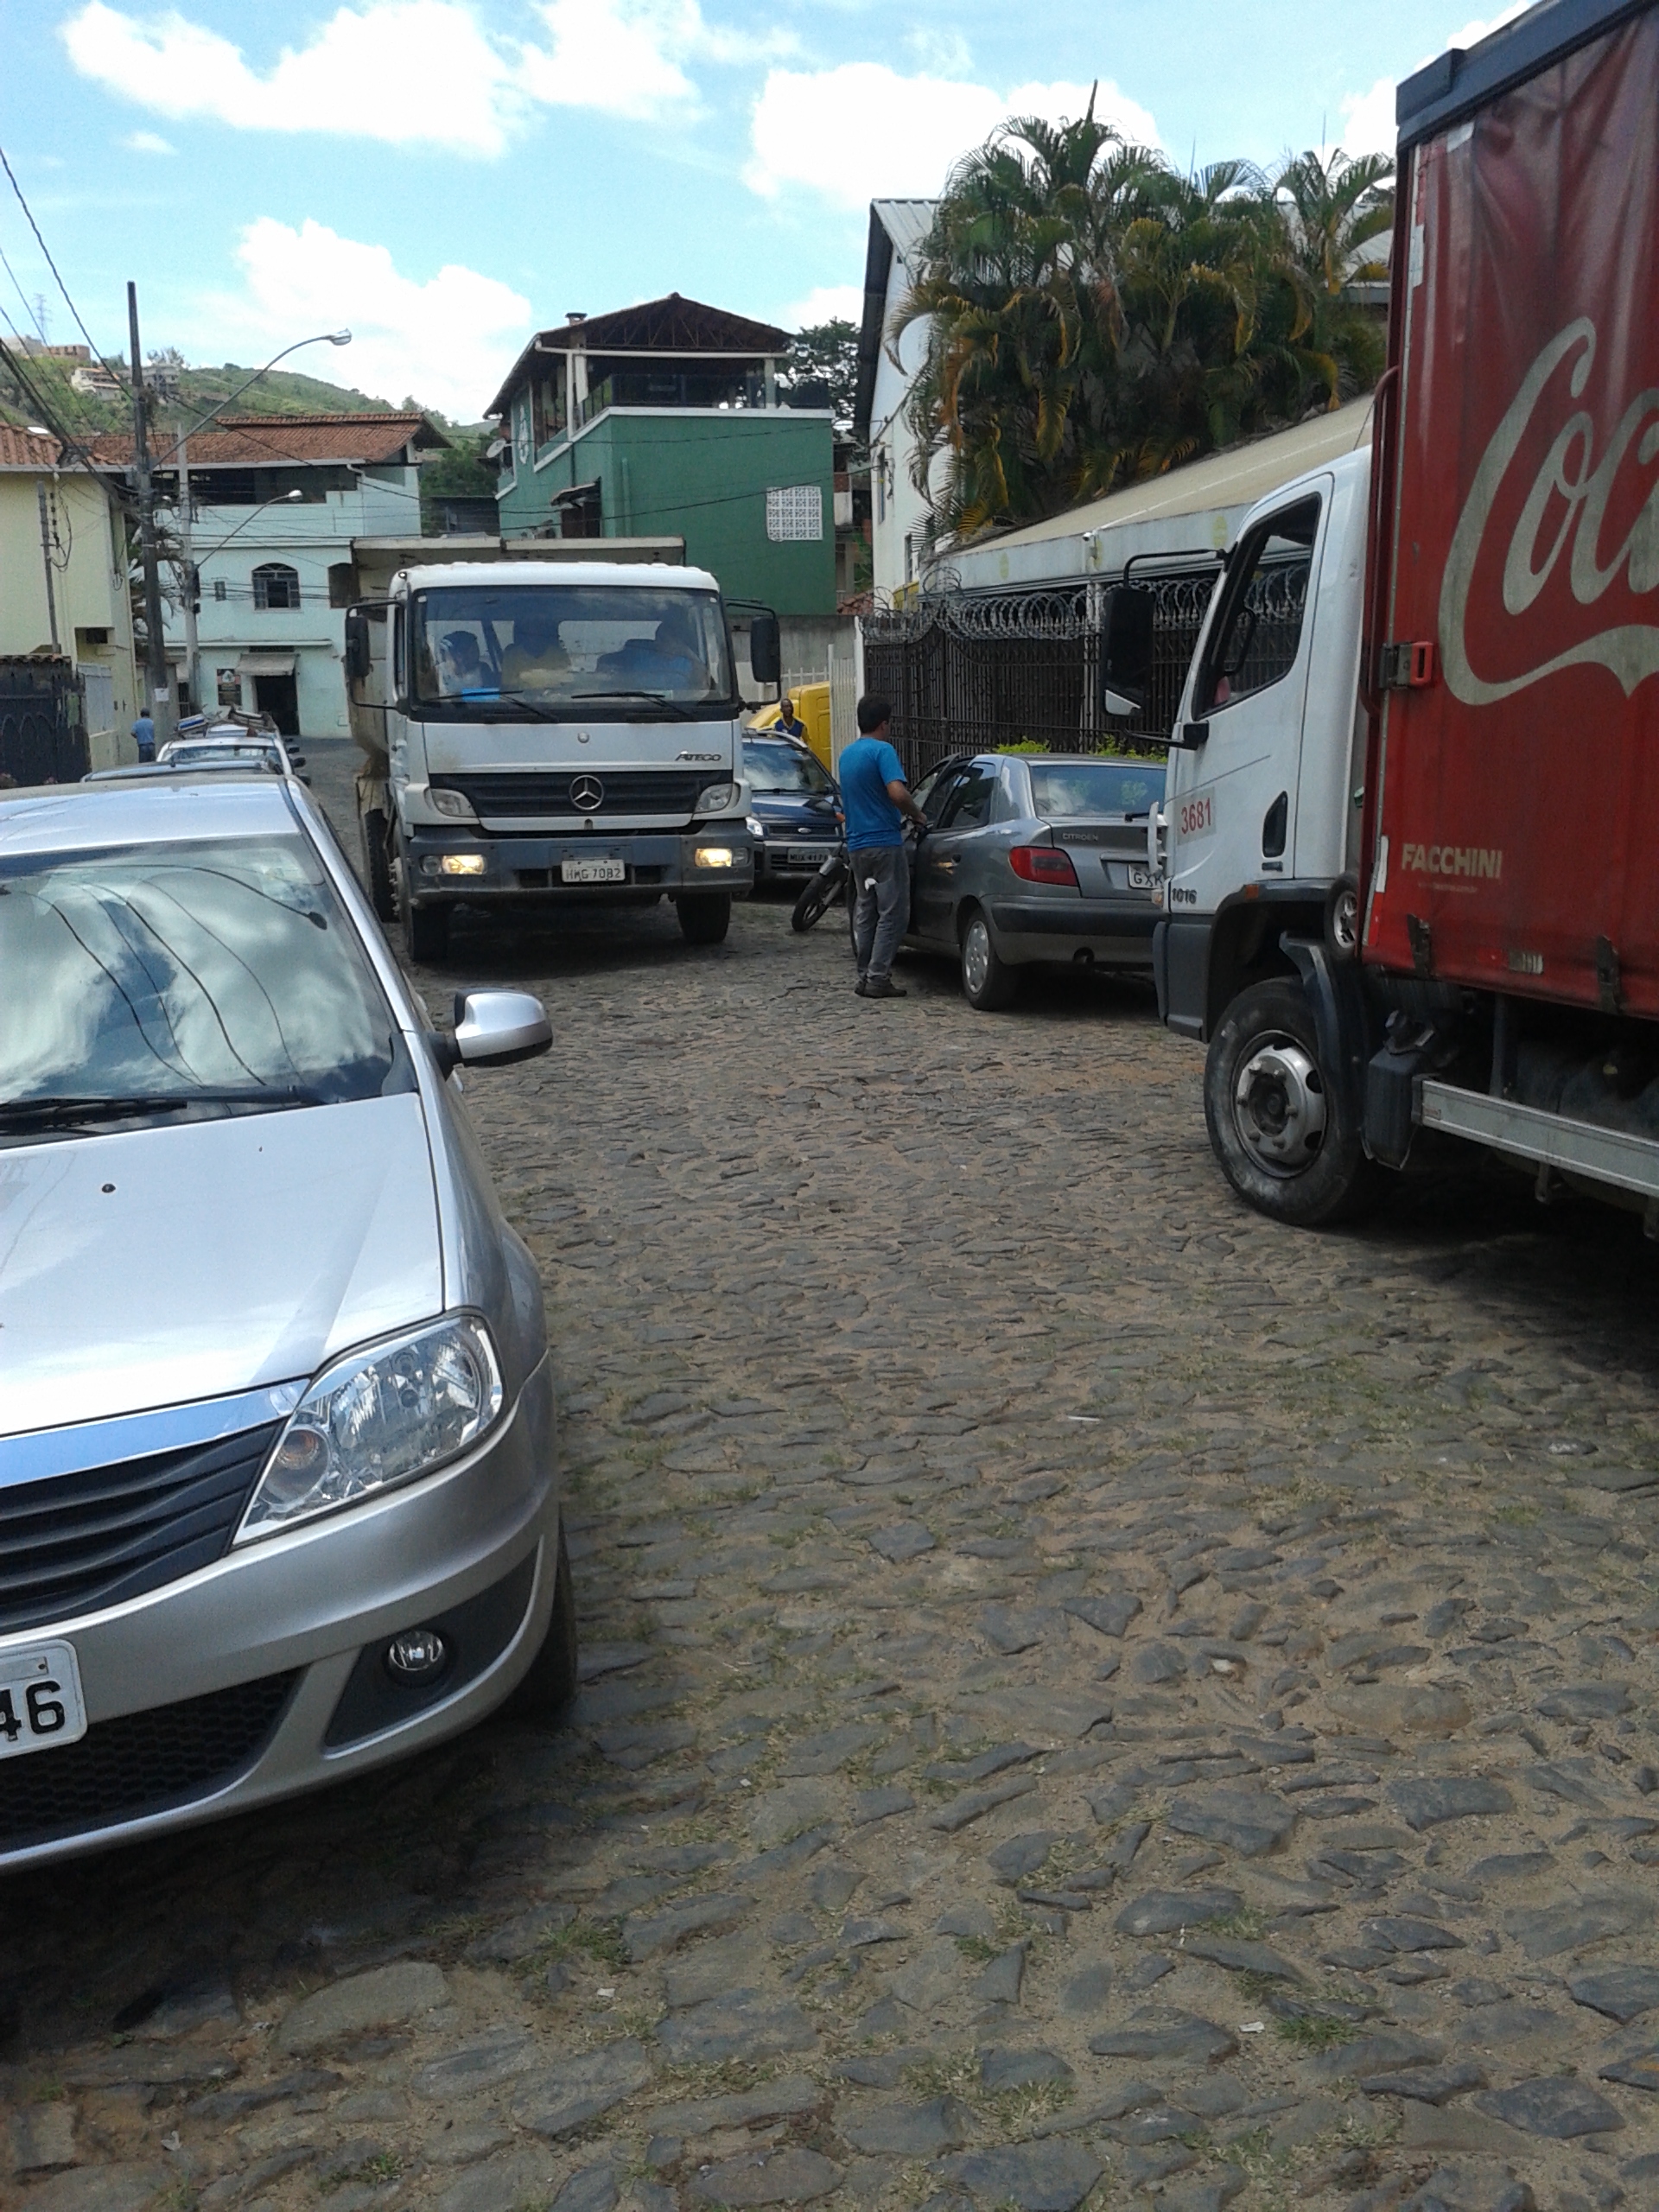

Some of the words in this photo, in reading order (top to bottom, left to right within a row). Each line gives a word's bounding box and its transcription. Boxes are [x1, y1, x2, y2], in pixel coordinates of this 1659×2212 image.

[1181, 797, 1211, 835] 3681
[1401, 843, 1503, 879] FACCHINI
[1172, 887, 1198, 904] 1016
